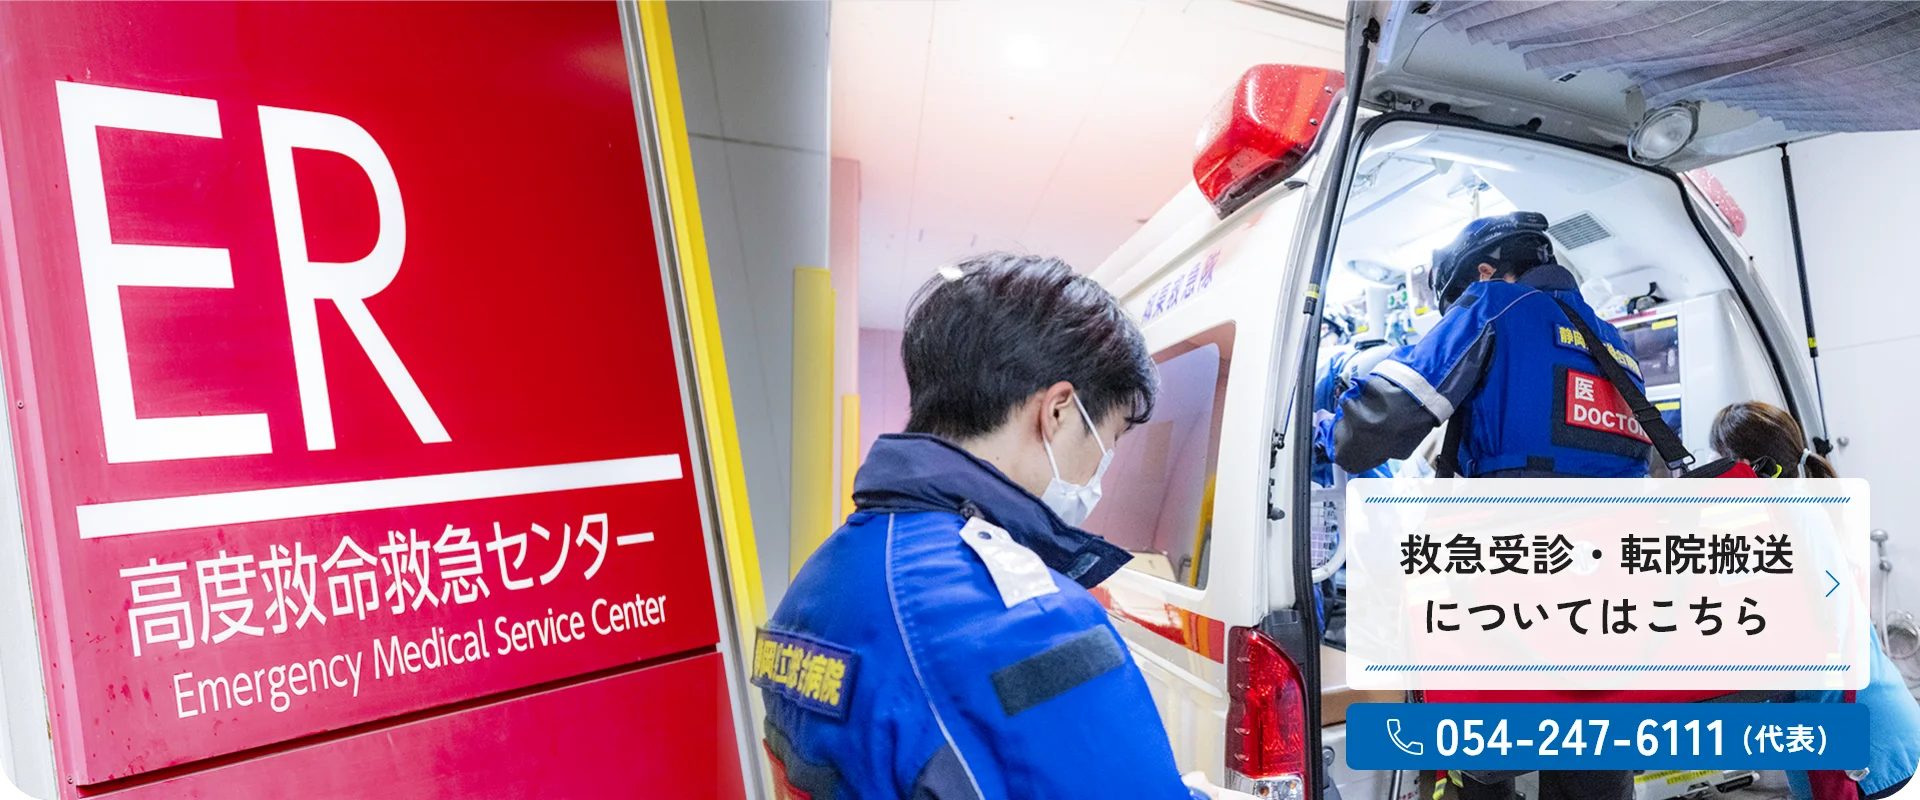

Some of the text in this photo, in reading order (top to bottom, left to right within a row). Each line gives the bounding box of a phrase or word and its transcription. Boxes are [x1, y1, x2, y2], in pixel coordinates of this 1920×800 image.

[55, 80, 452, 464] ER
[1575, 376, 1595, 402] 医
[119, 512, 655, 658] 高度救命救急センター
[173, 593, 667, 719] Emergency Medical Service Center
